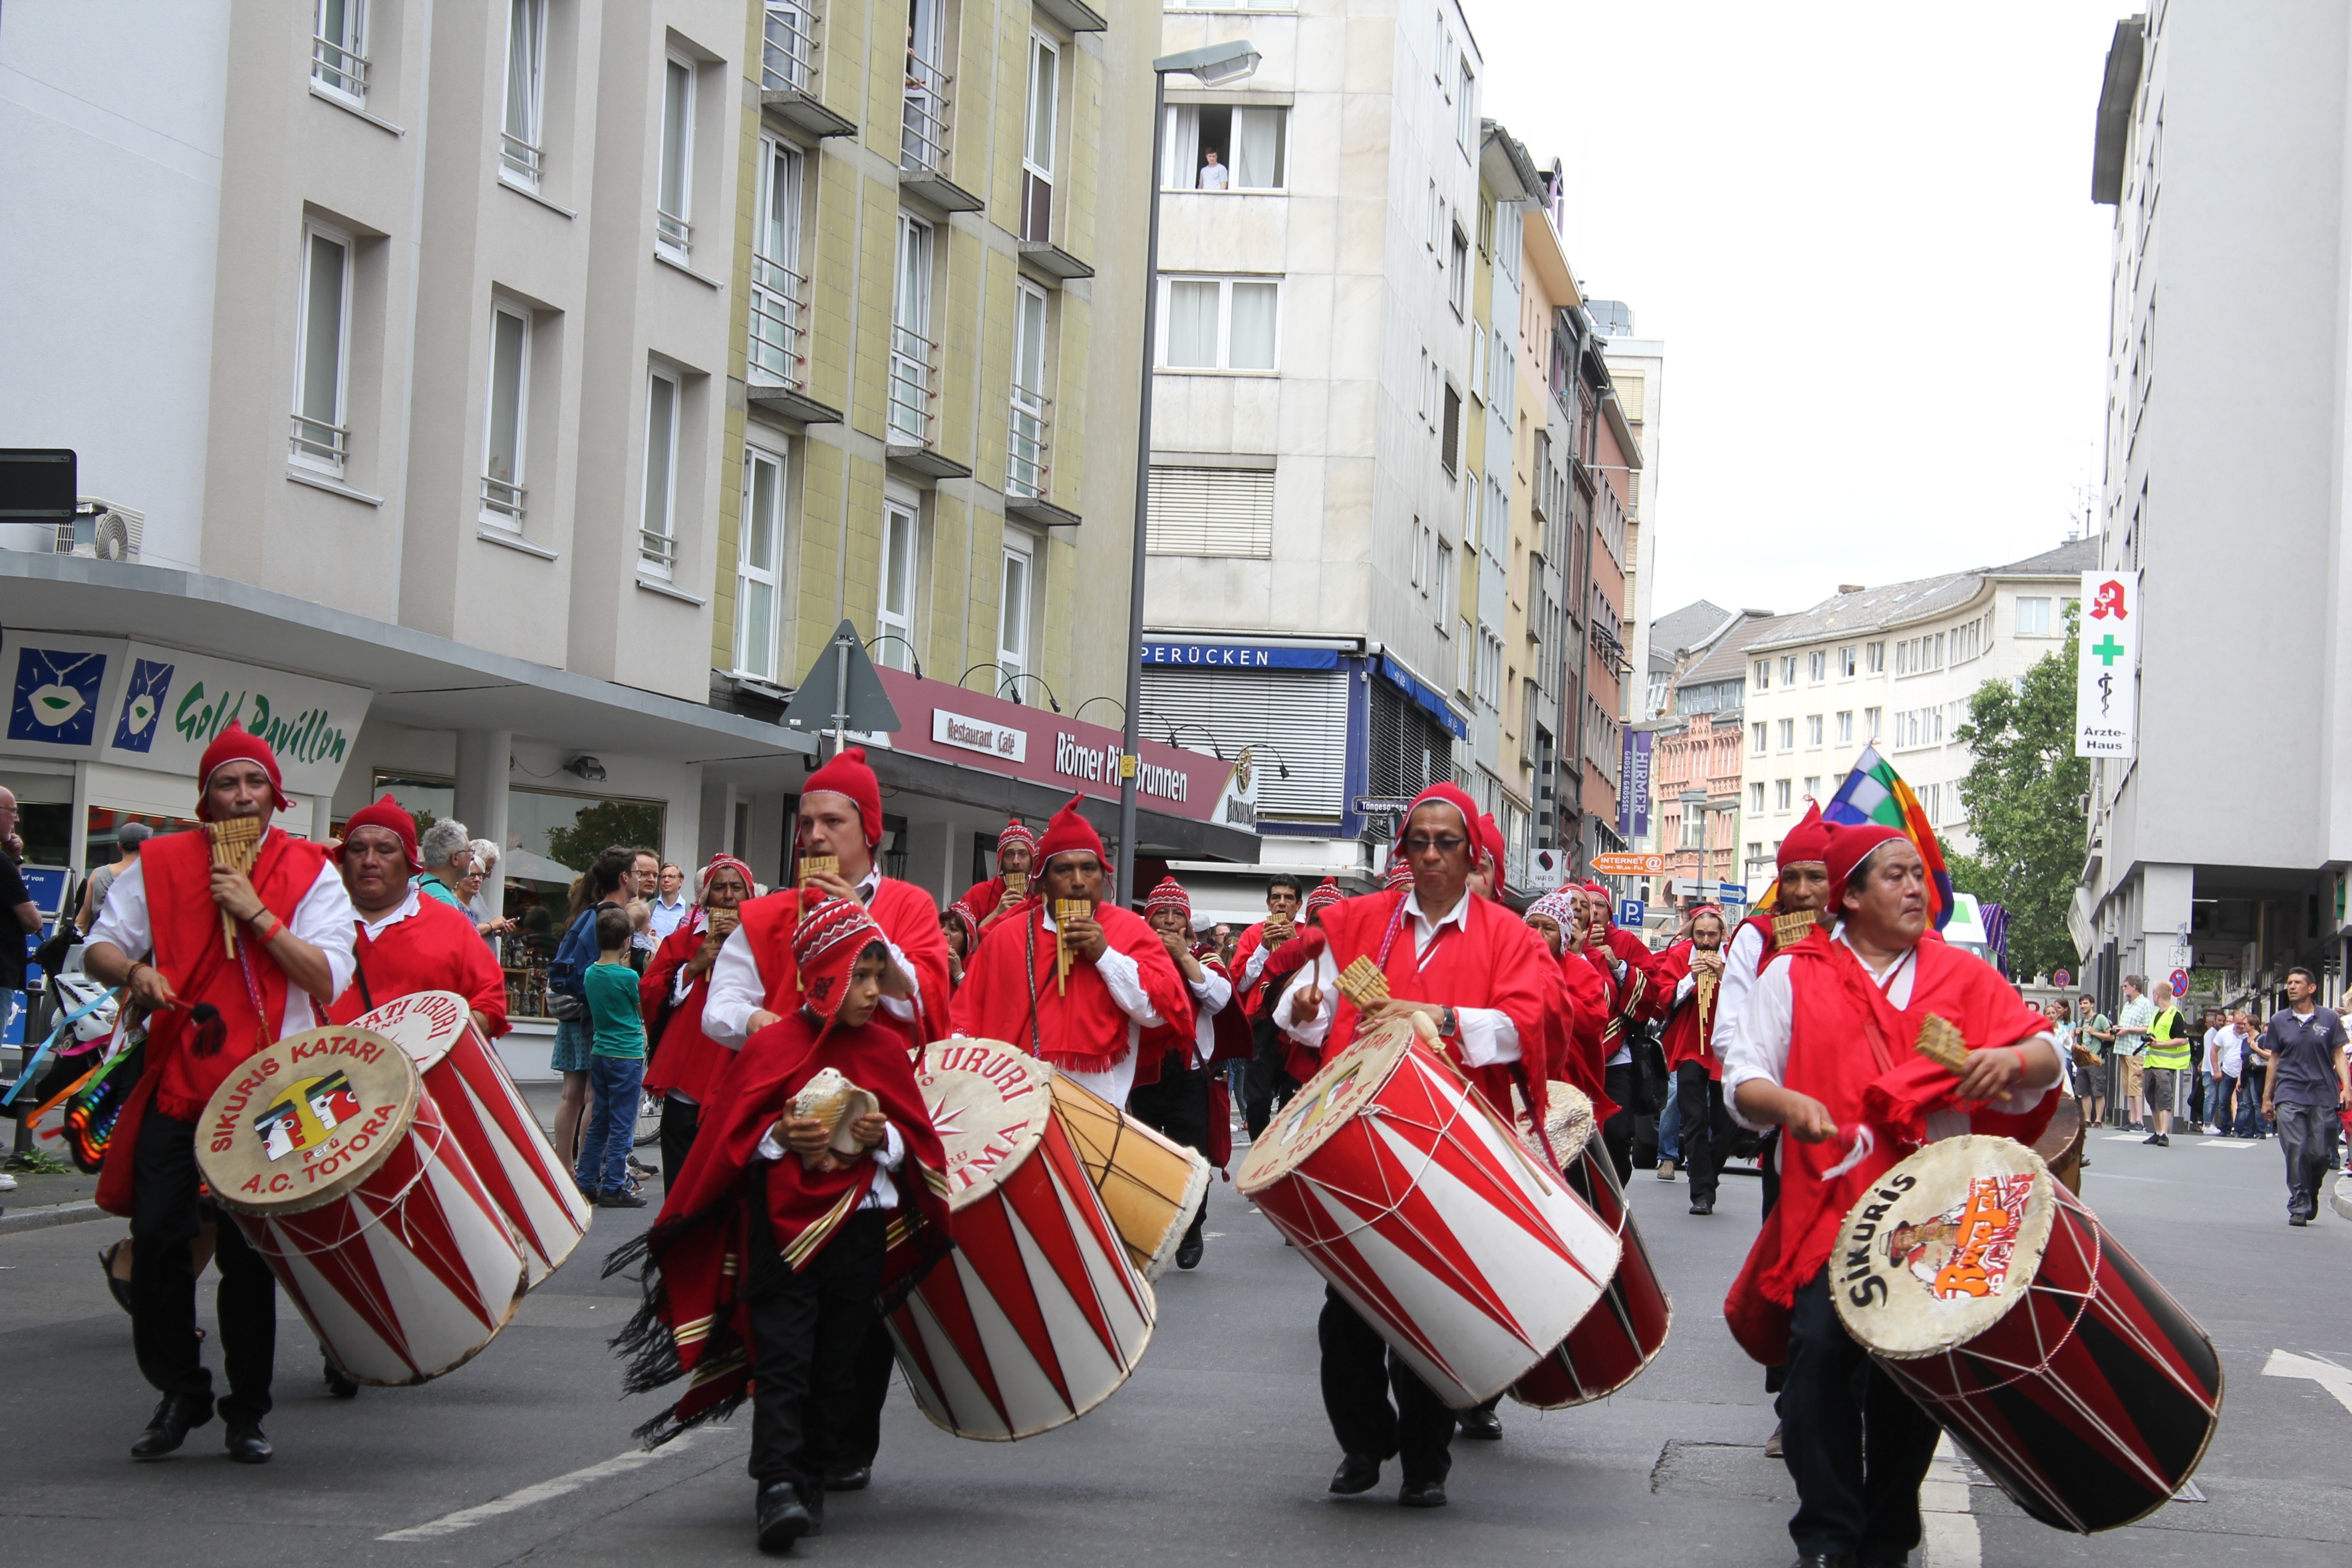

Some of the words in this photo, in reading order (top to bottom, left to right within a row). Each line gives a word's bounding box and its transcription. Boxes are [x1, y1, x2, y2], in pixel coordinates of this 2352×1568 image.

[1141, 647, 1268, 666] PERÜCKEN
[176, 681, 246, 744] Gold
[248, 694, 346, 764] Pavillon
[947, 717, 993, 749] Restaurant
[998, 731, 1016, 755] Café
[2084, 725, 2126, 737] Ärzte-
[1056, 731, 1104, 782] Römer
[1106, 745, 1124, 787] Pil
[2087, 740, 2122, 750] Haus
[1622, 781, 1631, 814] GRÖSSEN
[1635, 751, 1649, 815] HIRMER
[1227, 794, 1257, 828] BINDING
[1600, 857, 1645, 865] INTERNET
[1625, 902, 1639, 923] P
[412, 996, 458, 1041] URURI
[211, 1058, 280, 1152] SIKURIS
[290, 1037, 385, 1065] KATARI
[940, 1047, 1034, 1104] URURI
[240, 1174, 294, 1194] A.C.
[302, 1104, 396, 1183] TOTORA
